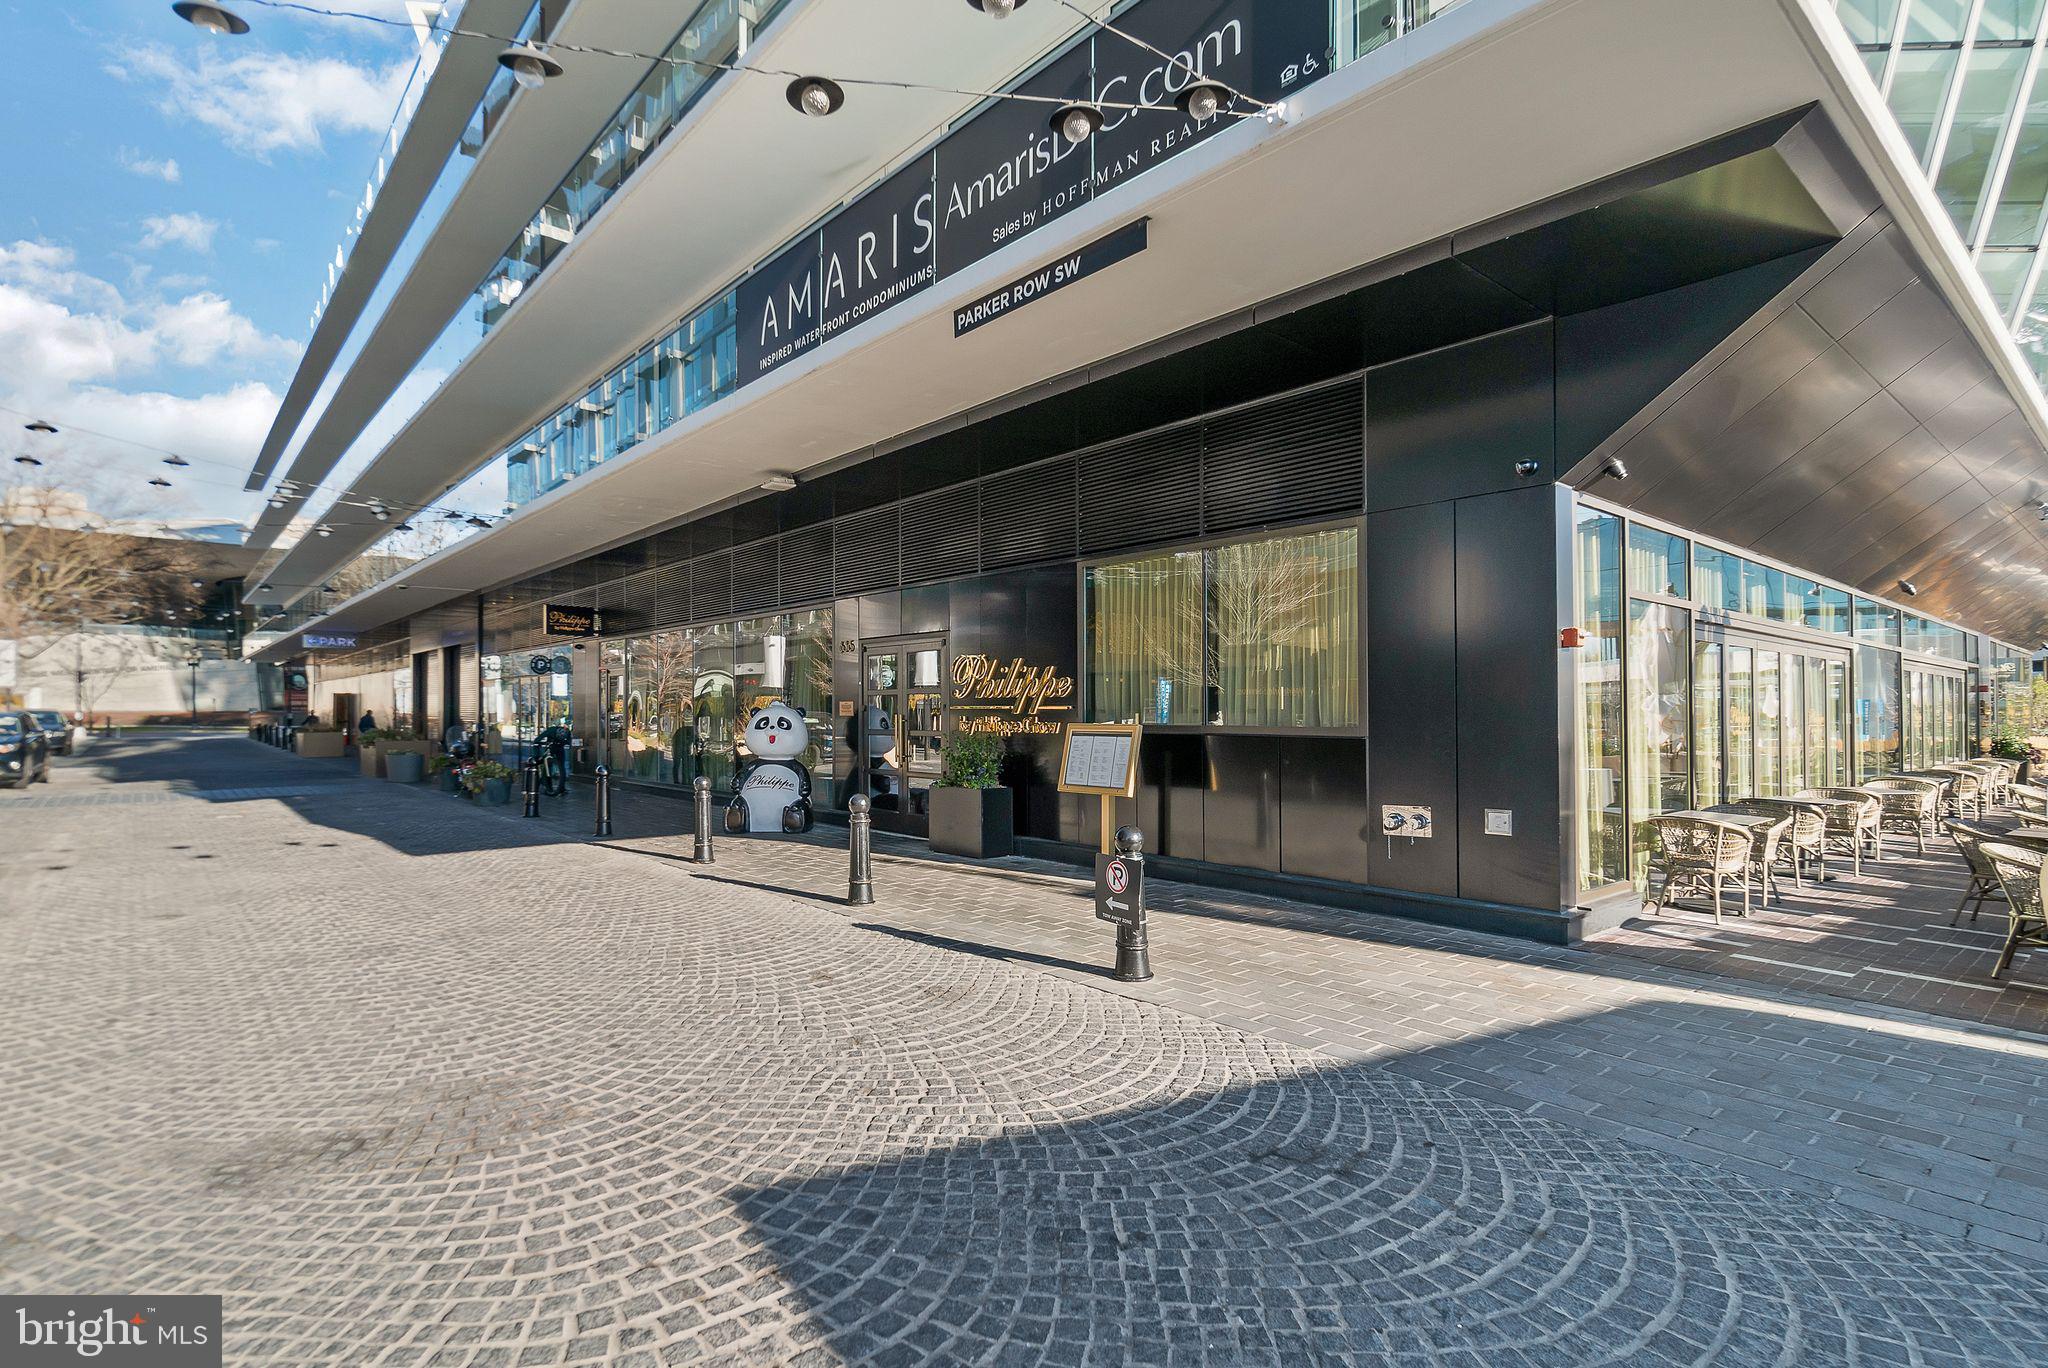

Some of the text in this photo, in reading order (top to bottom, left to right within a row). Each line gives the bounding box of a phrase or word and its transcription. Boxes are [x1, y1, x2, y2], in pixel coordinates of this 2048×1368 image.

[992, 220, 1020, 243] Sales
[1023, 209, 1037, 227] by
[1043, 150, 1139, 216] HOFFMAN
[761, 193, 932, 346] AMARIS
[958, 256, 1081, 330] PARKER ROW SW
[760, 275, 933, 370] INSPIRED WATERFRONT CONDOMINIUMS
[320, 637, 356, 647] PARK
[952, 654, 1072, 714] Philippe
[746, 775, 795, 790] Philippe
